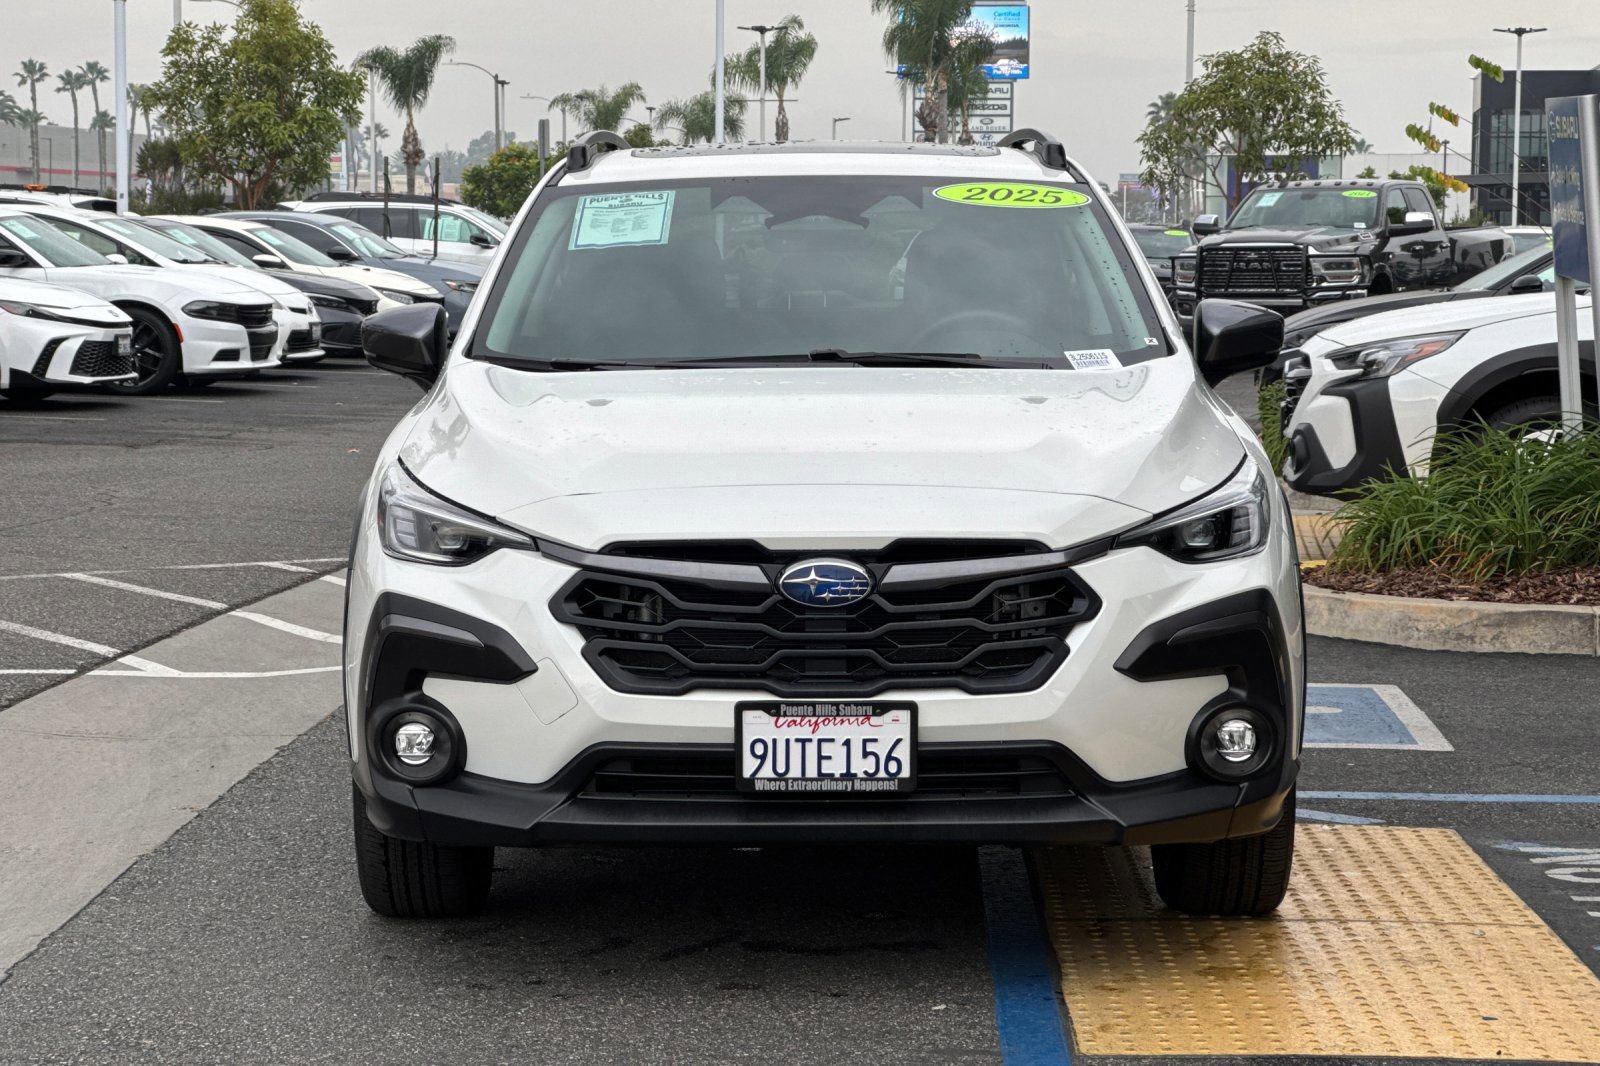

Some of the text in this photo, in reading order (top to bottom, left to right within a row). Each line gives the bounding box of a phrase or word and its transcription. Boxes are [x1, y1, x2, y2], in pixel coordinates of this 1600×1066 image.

[1555, 116, 1579, 139] SUBARU
[962, 187, 1065, 204] 2025
[780, 704, 873, 716] Puente Hills Subaru
[774, 715, 883, 735] California
[750, 737, 904, 778] 9UTE156
[754, 779, 899, 791] Where Extraordinary Happens!
